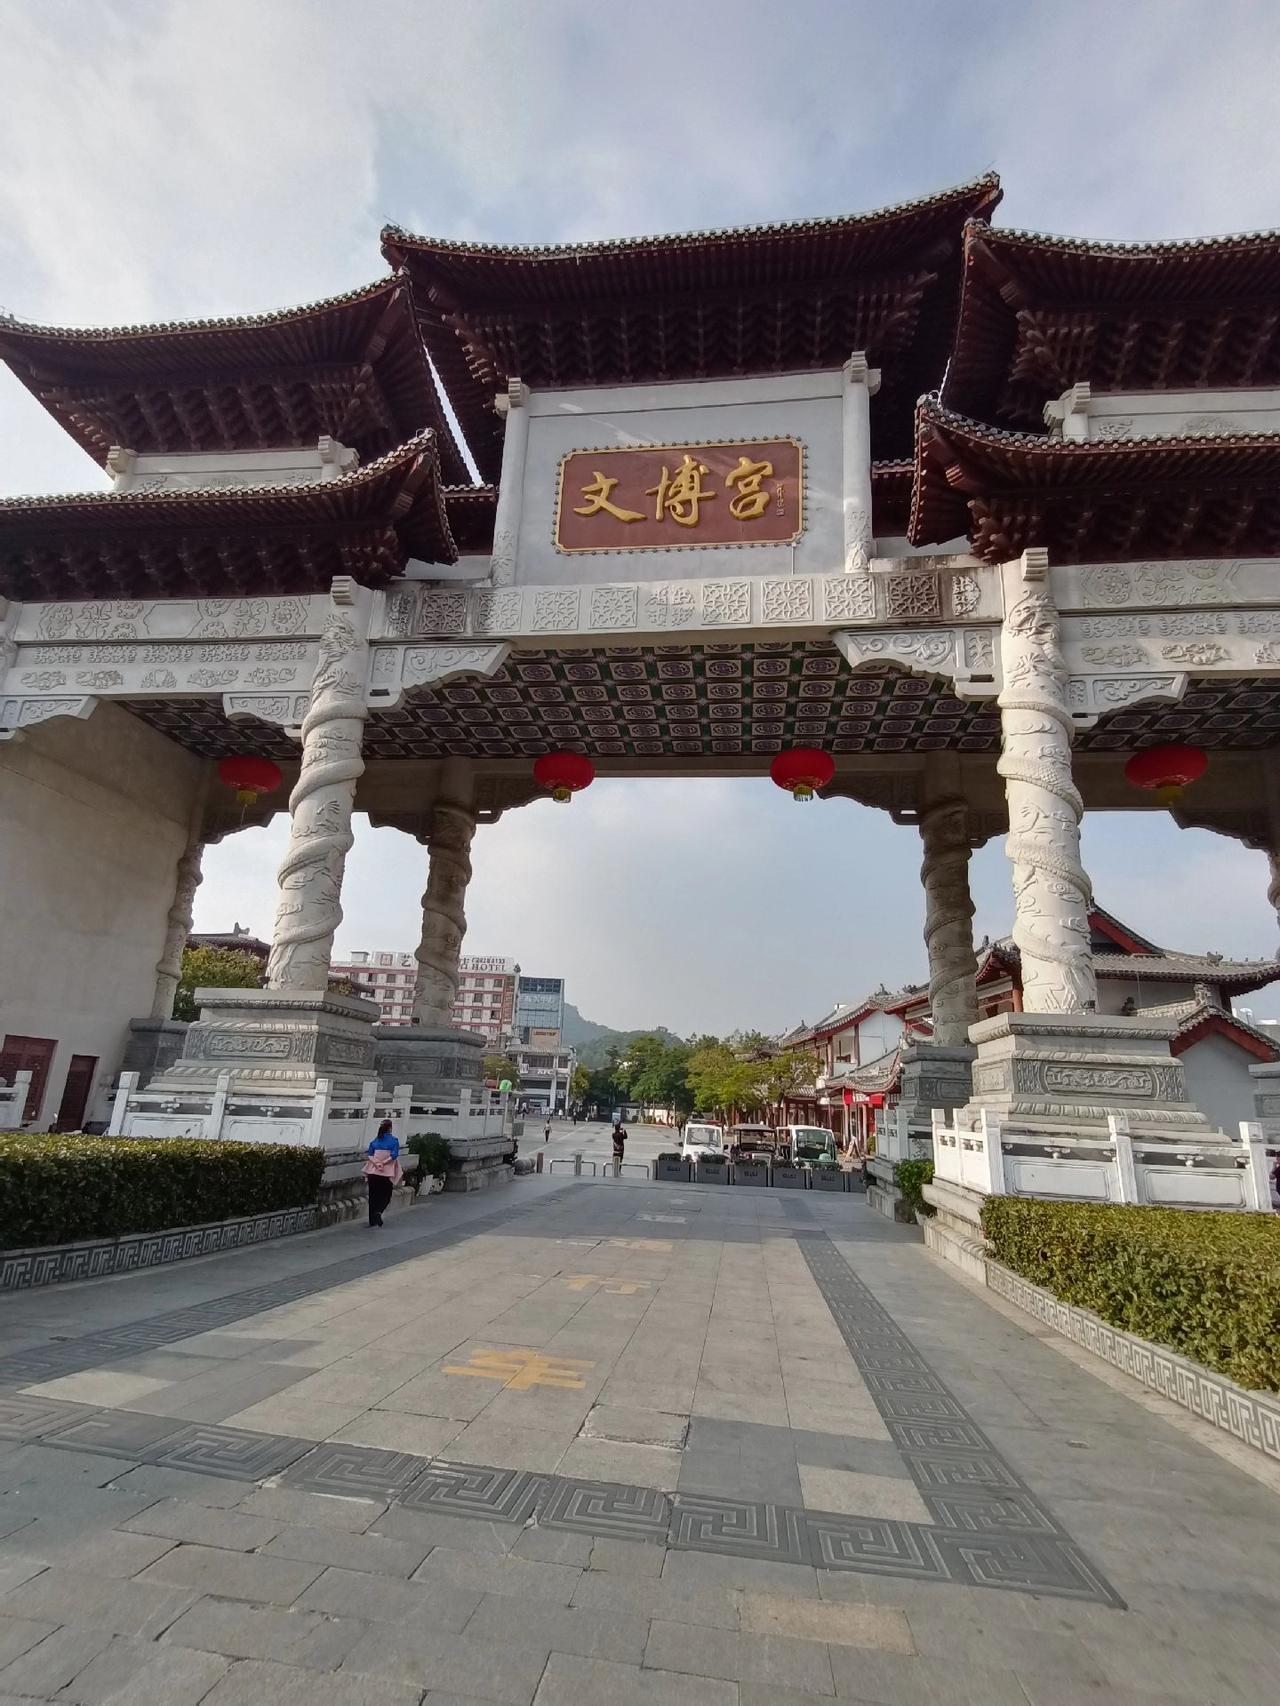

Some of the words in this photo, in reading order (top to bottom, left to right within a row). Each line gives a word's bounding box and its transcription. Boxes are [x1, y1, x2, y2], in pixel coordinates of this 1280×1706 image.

[573, 454, 774, 528] 文博宫
[472, 963, 505, 972] HOTEL
